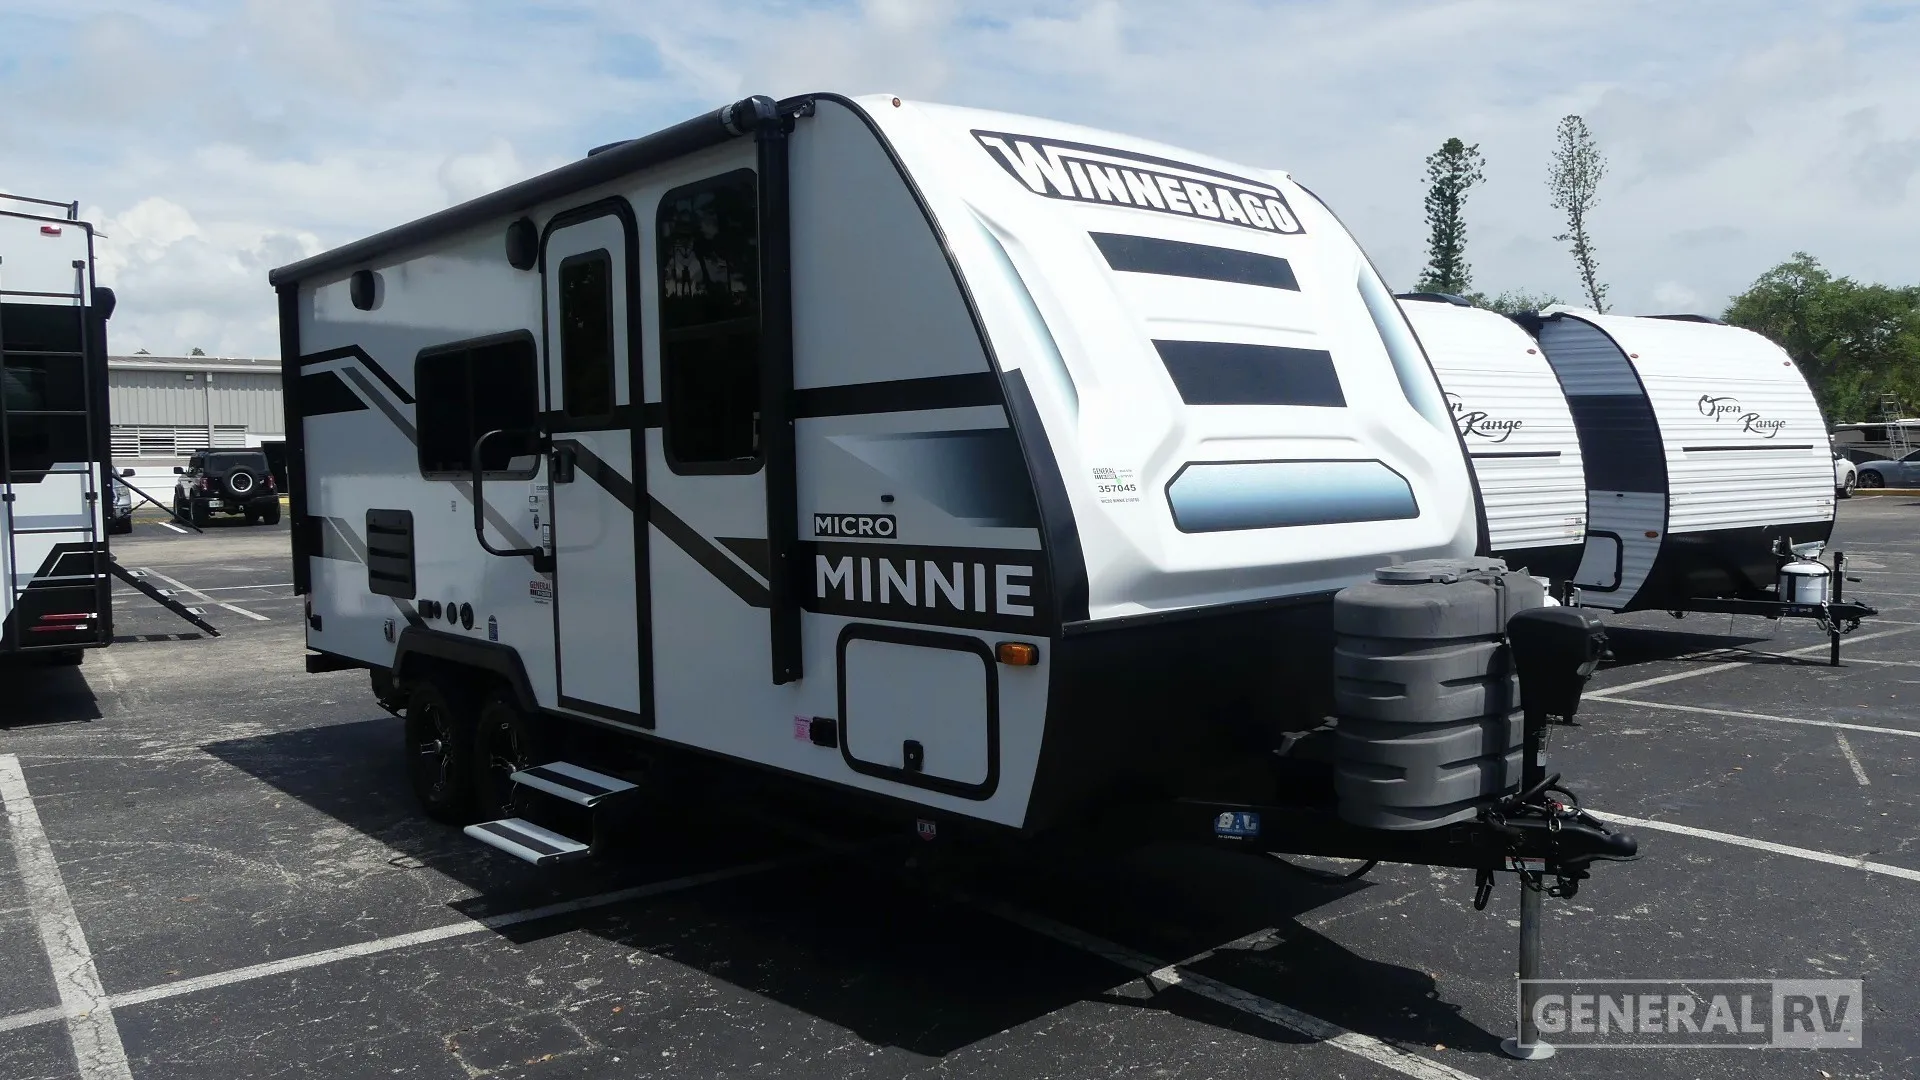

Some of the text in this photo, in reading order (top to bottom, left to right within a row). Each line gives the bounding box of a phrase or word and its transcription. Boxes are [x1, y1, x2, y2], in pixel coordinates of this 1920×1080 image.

[978, 135, 1299, 234] WINNEBAGO
[1698, 394, 1742, 423] Open
[1456, 411, 1523, 443] Range
[1736, 412, 1786, 439] Range
[1097, 484, 1137, 493] 357045
[815, 516, 894, 536] MICRO
[815, 554, 1034, 617] MINNIE
